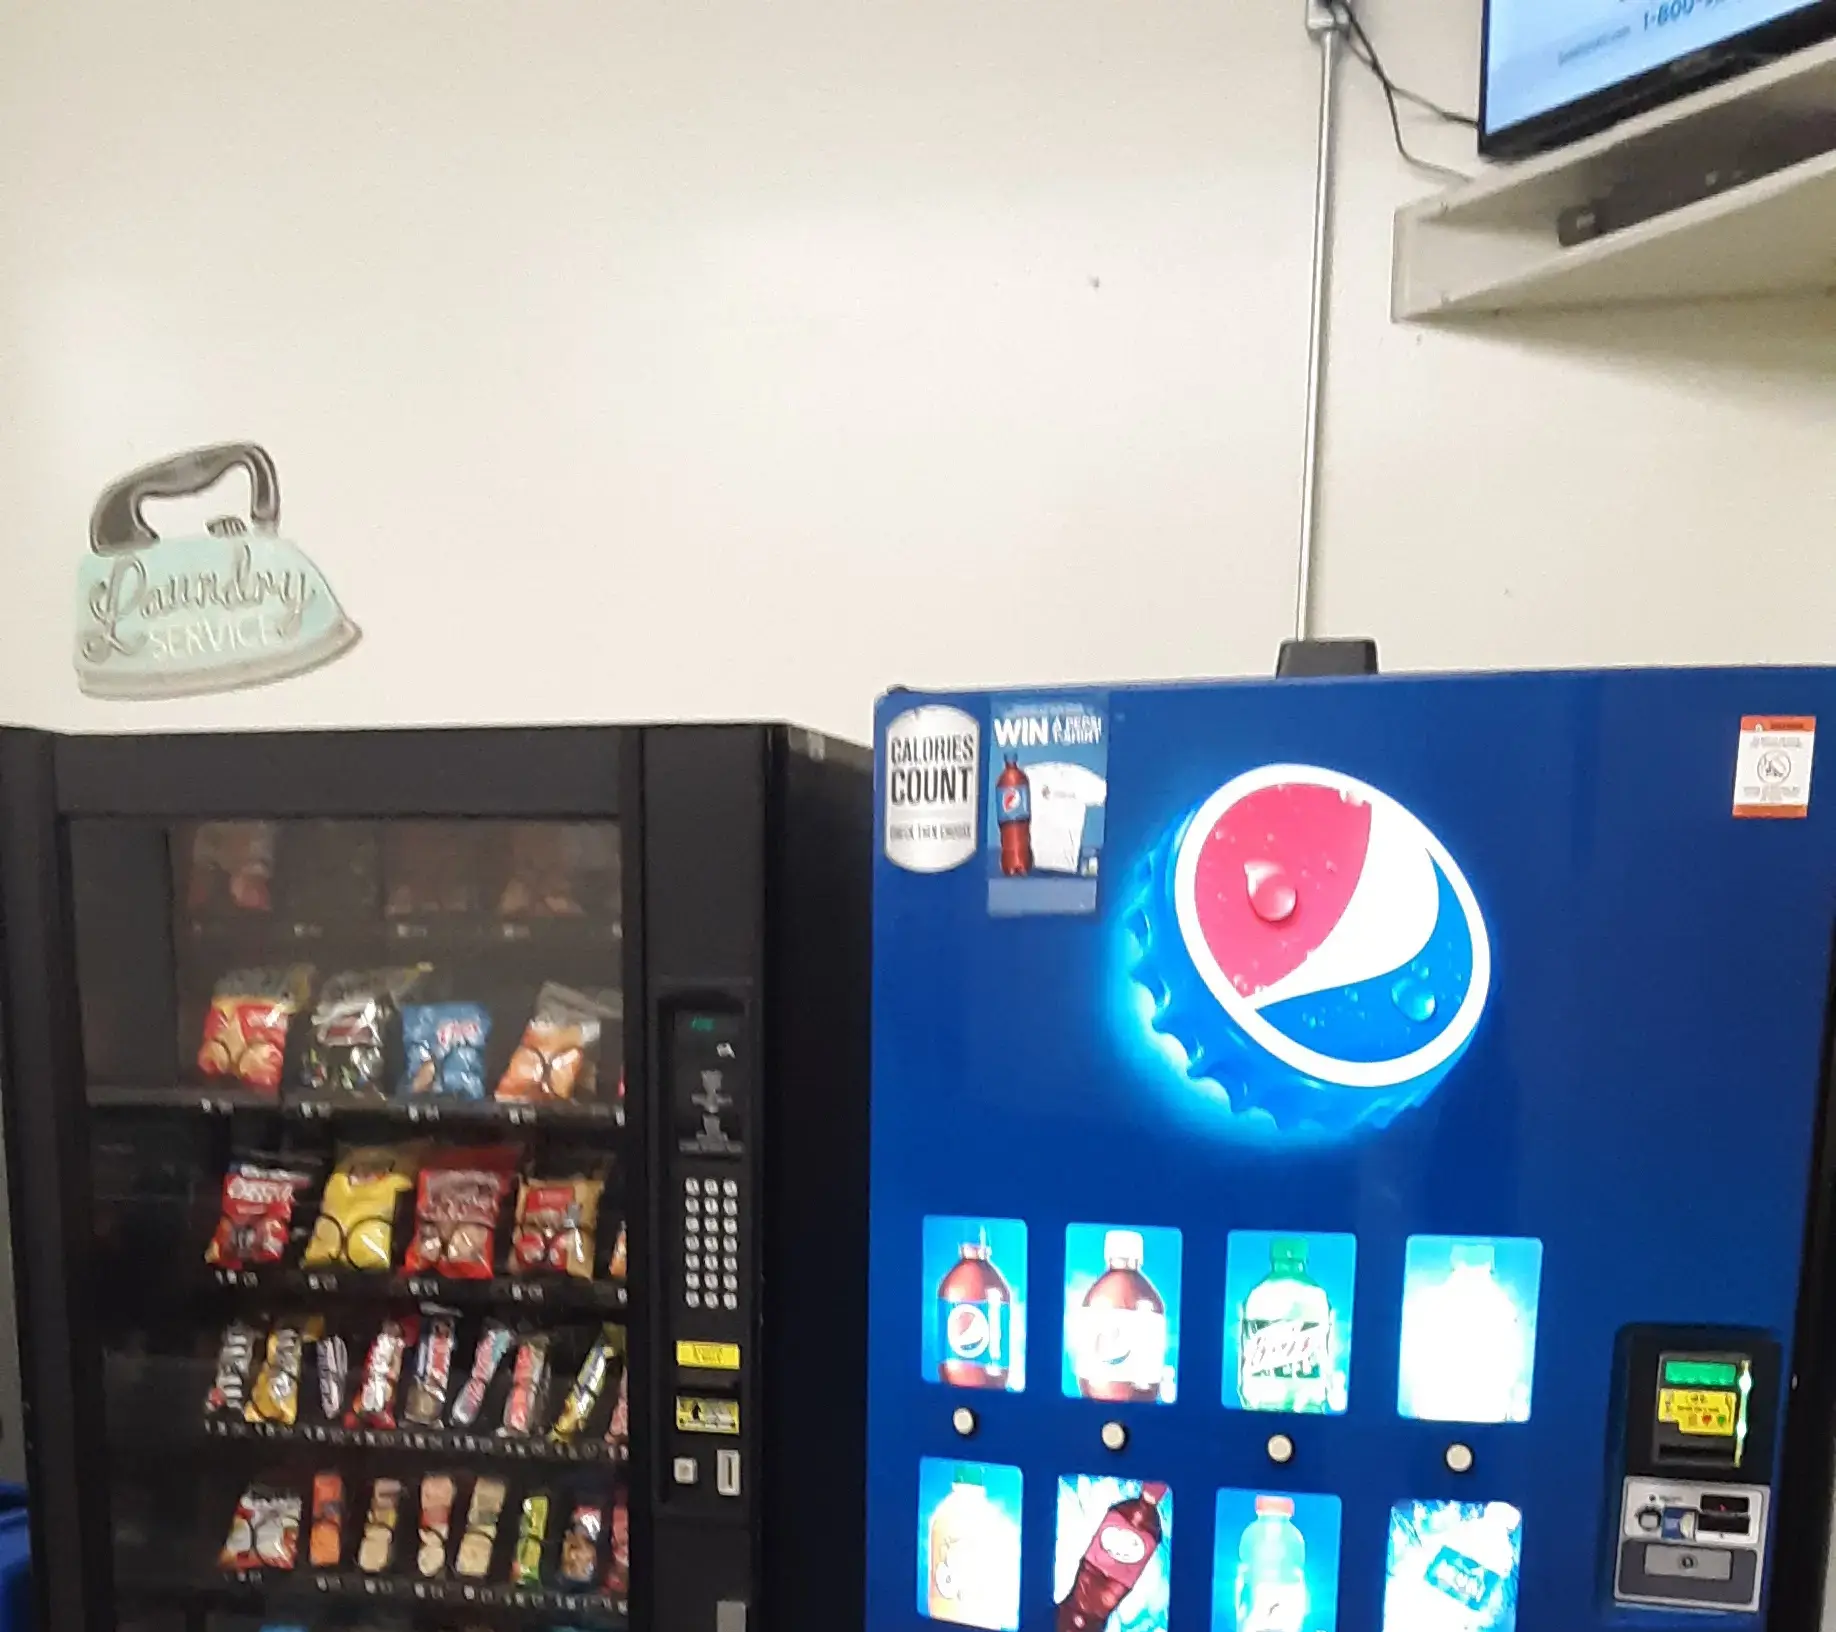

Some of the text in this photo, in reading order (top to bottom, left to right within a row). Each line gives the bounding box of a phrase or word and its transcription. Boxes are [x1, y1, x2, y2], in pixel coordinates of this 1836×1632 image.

[82, 543, 318, 663] Laundry
[148, 614, 270, 660] SERVICE
[891, 734, 974, 764] CALORIES
[994, 716, 1049, 748] WIN
[891, 765, 973, 806] COUNT
